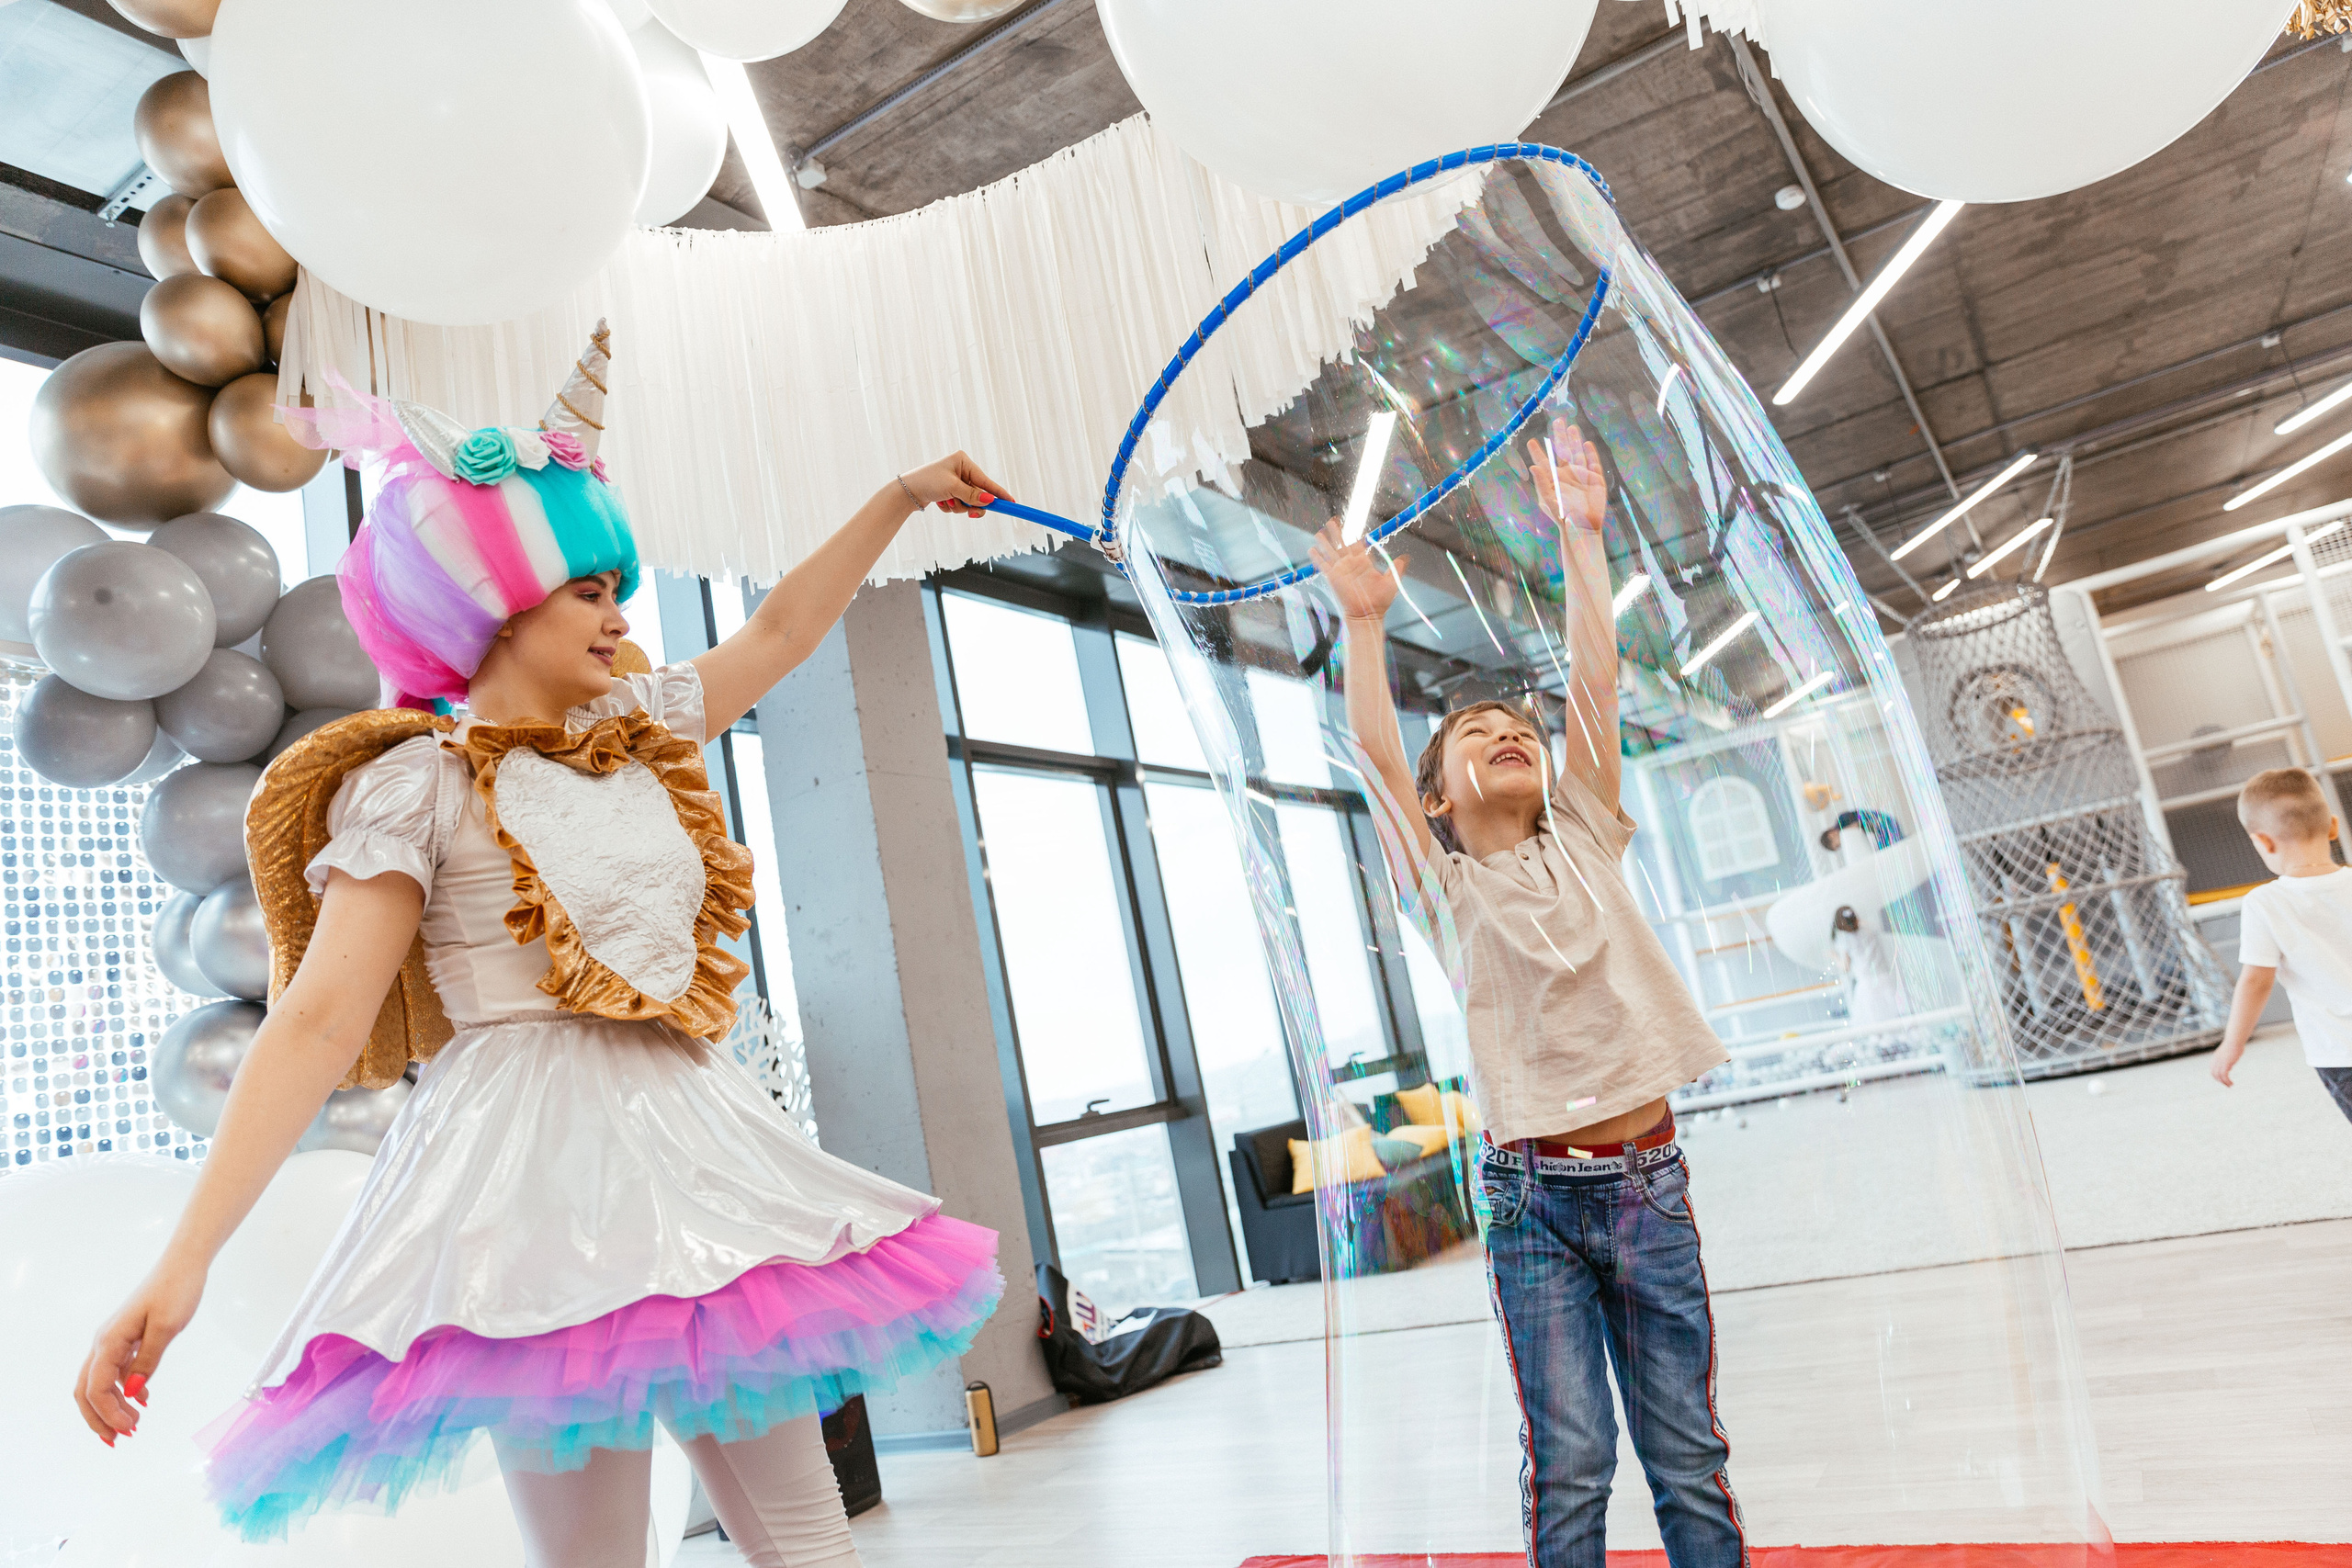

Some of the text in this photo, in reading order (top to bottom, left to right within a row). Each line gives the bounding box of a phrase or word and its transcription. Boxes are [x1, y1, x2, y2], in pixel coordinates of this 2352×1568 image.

[1482, 1142, 1509, 1165] 520
[1512, 1156, 1576, 1172] Fshion
[1637, 1143, 1671, 1167] 520
